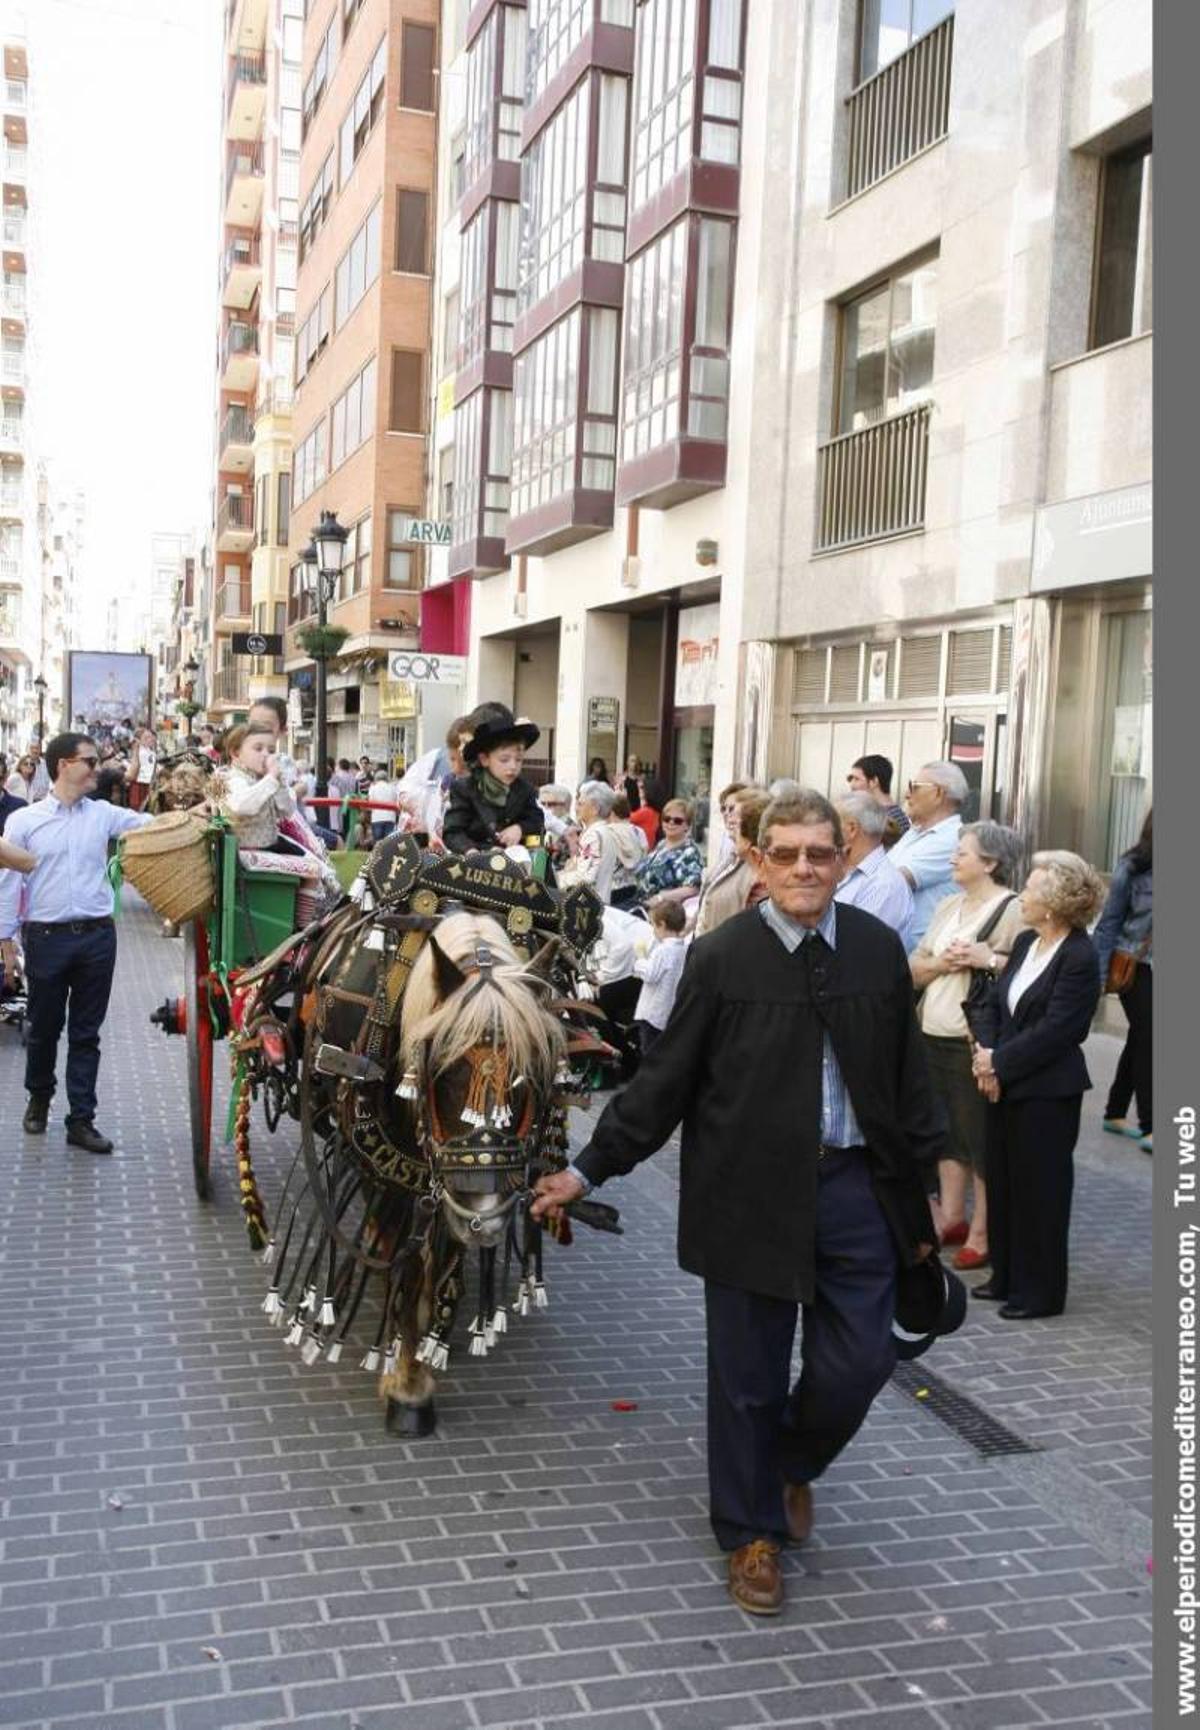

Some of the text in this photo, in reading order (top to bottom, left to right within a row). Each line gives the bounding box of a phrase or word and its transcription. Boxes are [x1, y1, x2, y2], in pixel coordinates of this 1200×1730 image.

[391, 654, 440, 681] GOR
[389, 855, 407, 880] F
[464, 866, 524, 894] LUSERA
